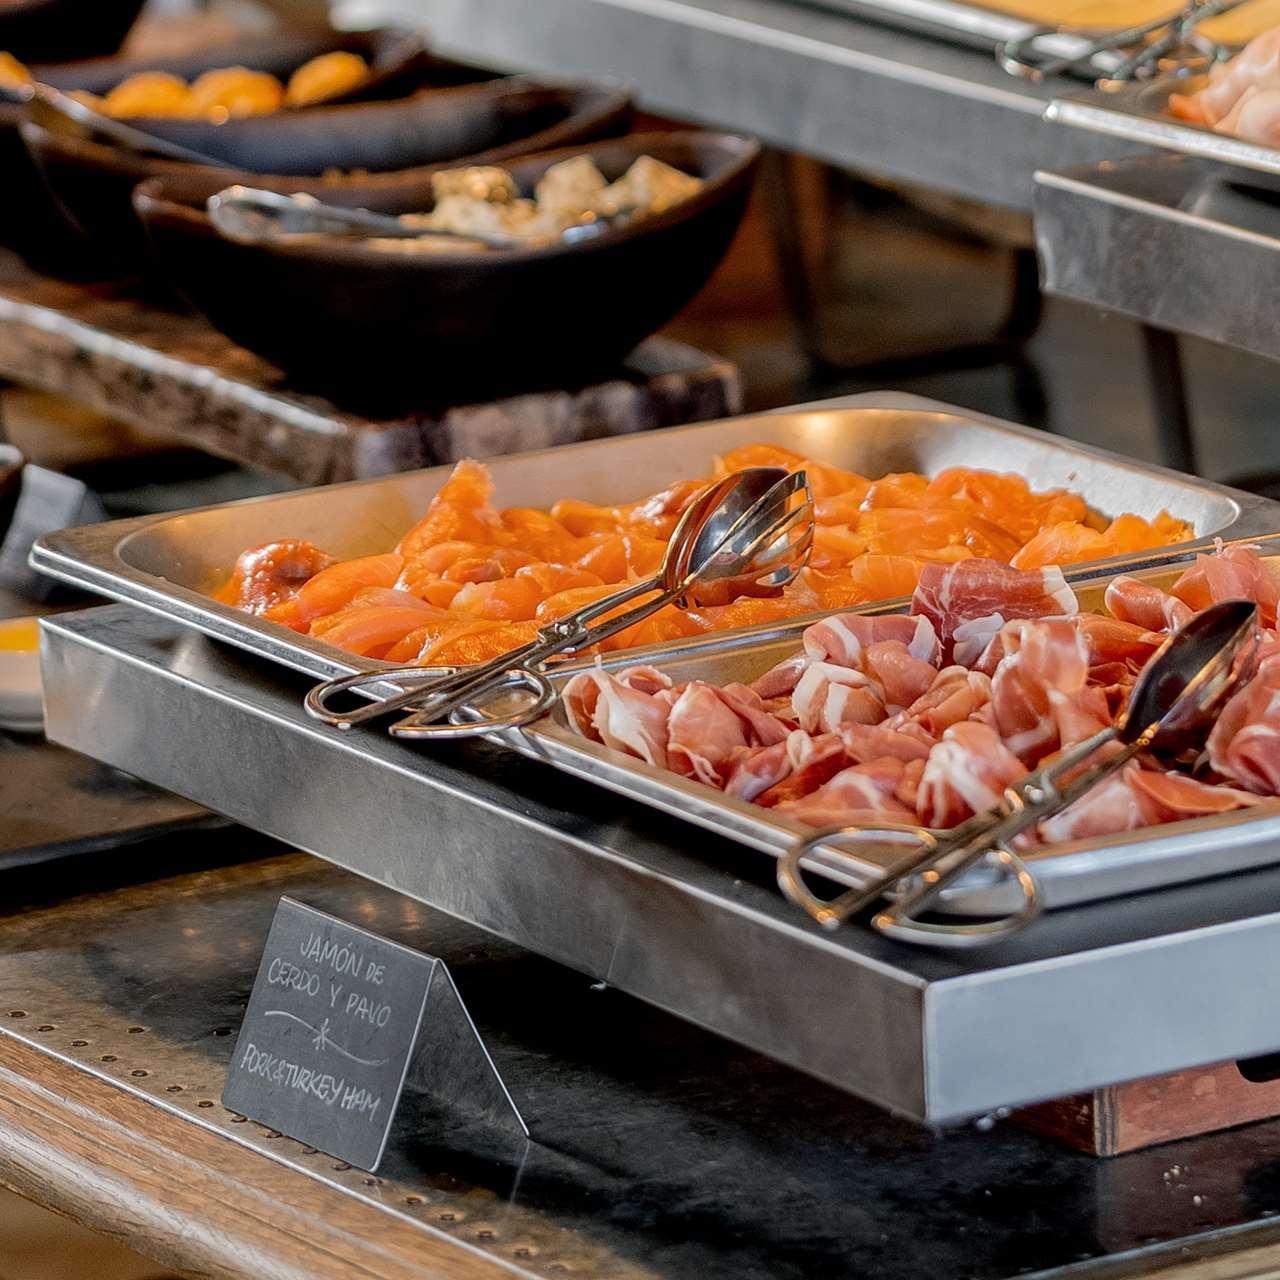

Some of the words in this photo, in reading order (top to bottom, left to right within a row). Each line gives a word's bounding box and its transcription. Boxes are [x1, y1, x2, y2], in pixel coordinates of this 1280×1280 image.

[300, 932, 362, 977] JAMÓN
[366, 961, 387, 985] DE
[268, 958, 321, 996] CERDO
[329, 983, 342, 1008] Y
[345, 993, 392, 1027] PAVO
[340, 1086, 380, 1122] HAM
